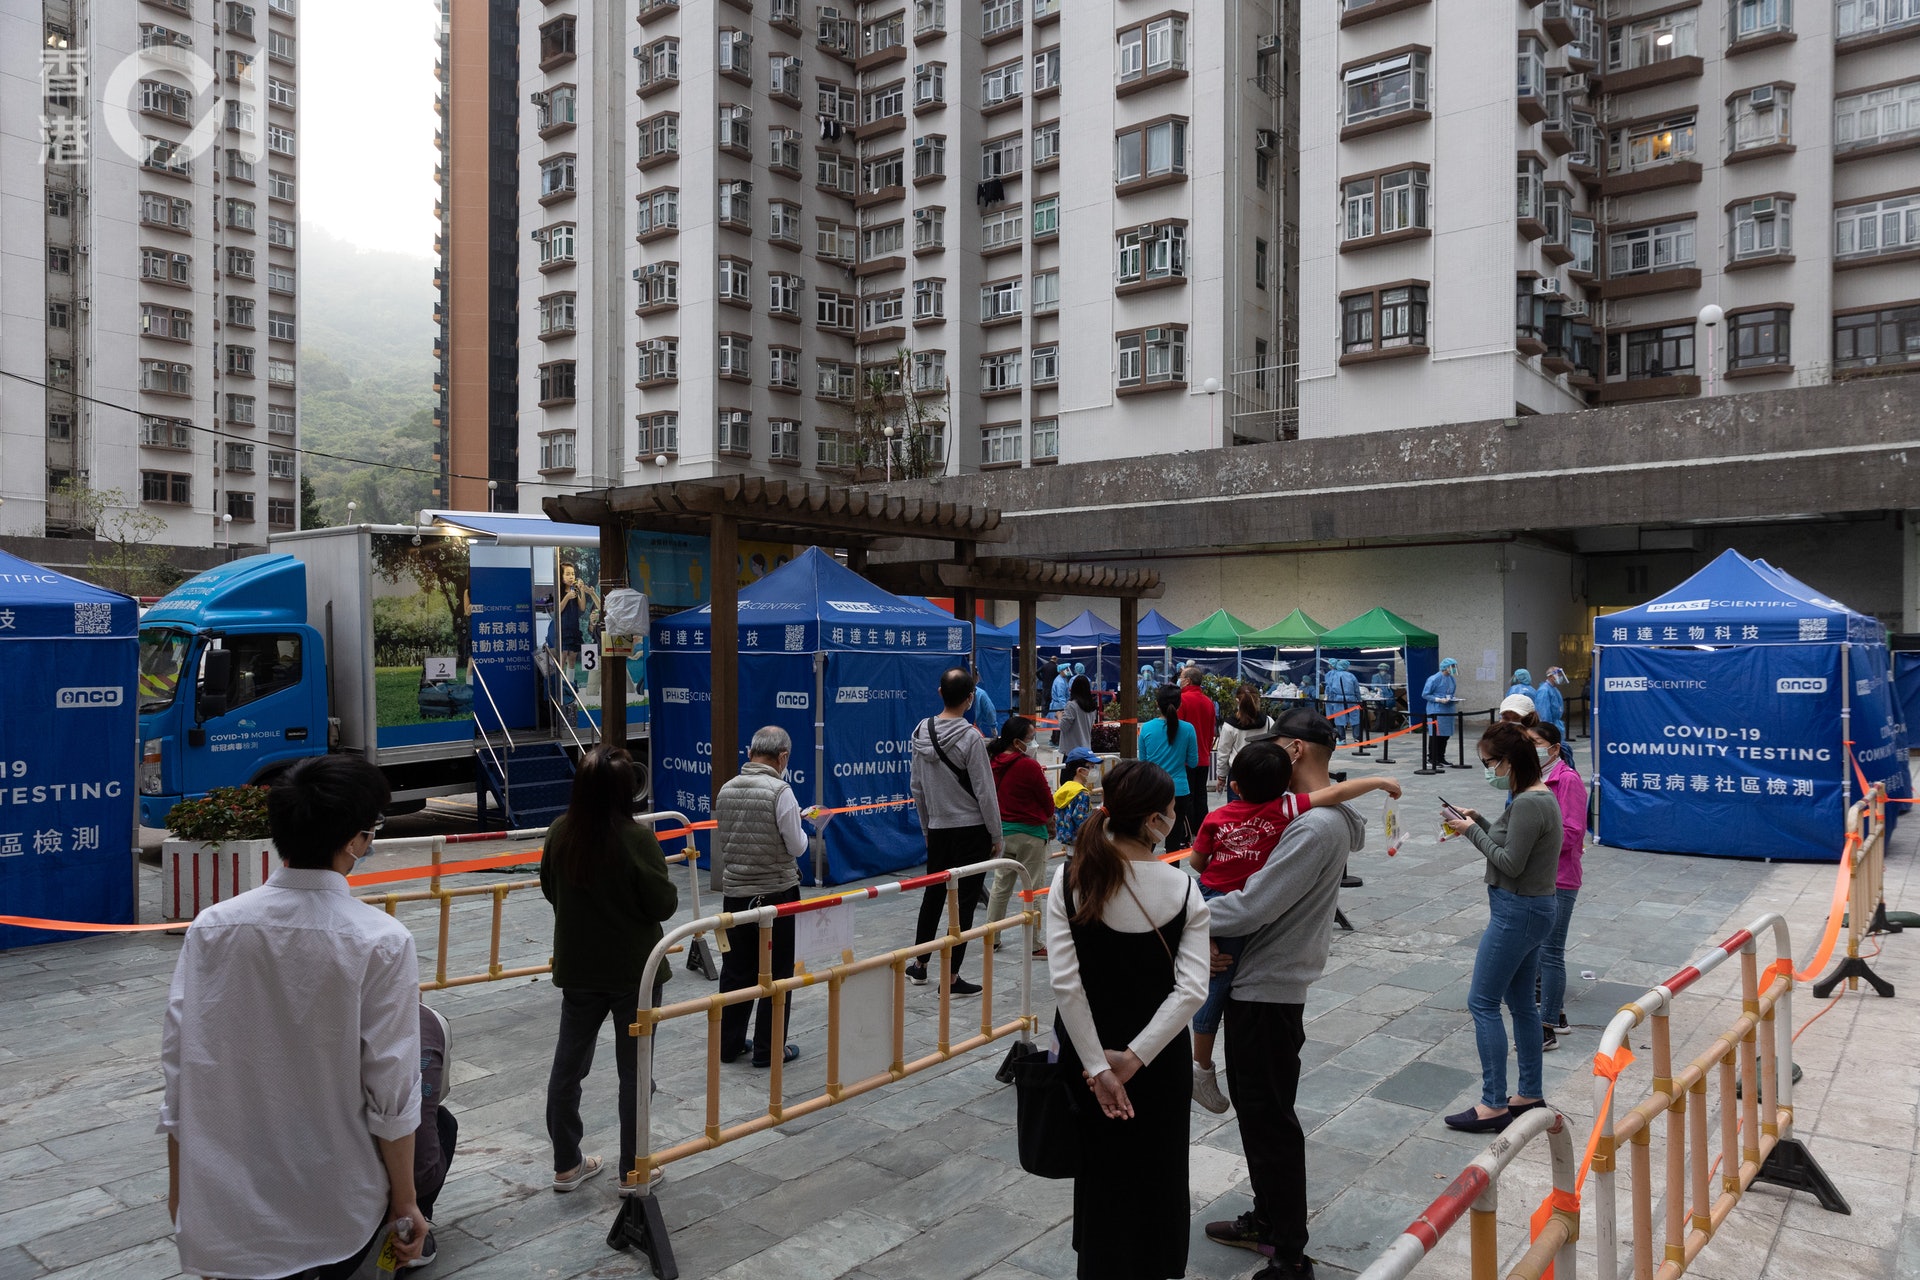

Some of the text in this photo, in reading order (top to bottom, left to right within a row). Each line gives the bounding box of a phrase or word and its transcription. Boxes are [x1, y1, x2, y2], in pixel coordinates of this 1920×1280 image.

[479, 622, 529, 635] 新冠病毒
[832, 627, 927, 646] 相達生物科技
[1612, 625, 1759, 641] 相達生物科技
[660, 629, 758, 647] 相達生技
[438, 663, 446, 673] 2
[584, 650, 596, 670] 3
[210, 732, 249, 742] COVID-19
[251, 730, 280, 739] MOBILE
[1663, 725, 1761, 741] COVID-19
[875, 740, 912, 754] COVID
[1606, 742, 1831, 762] COMMUNITY TESTING
[1621, 772, 1814, 797] 新冠病毒社區檢測
